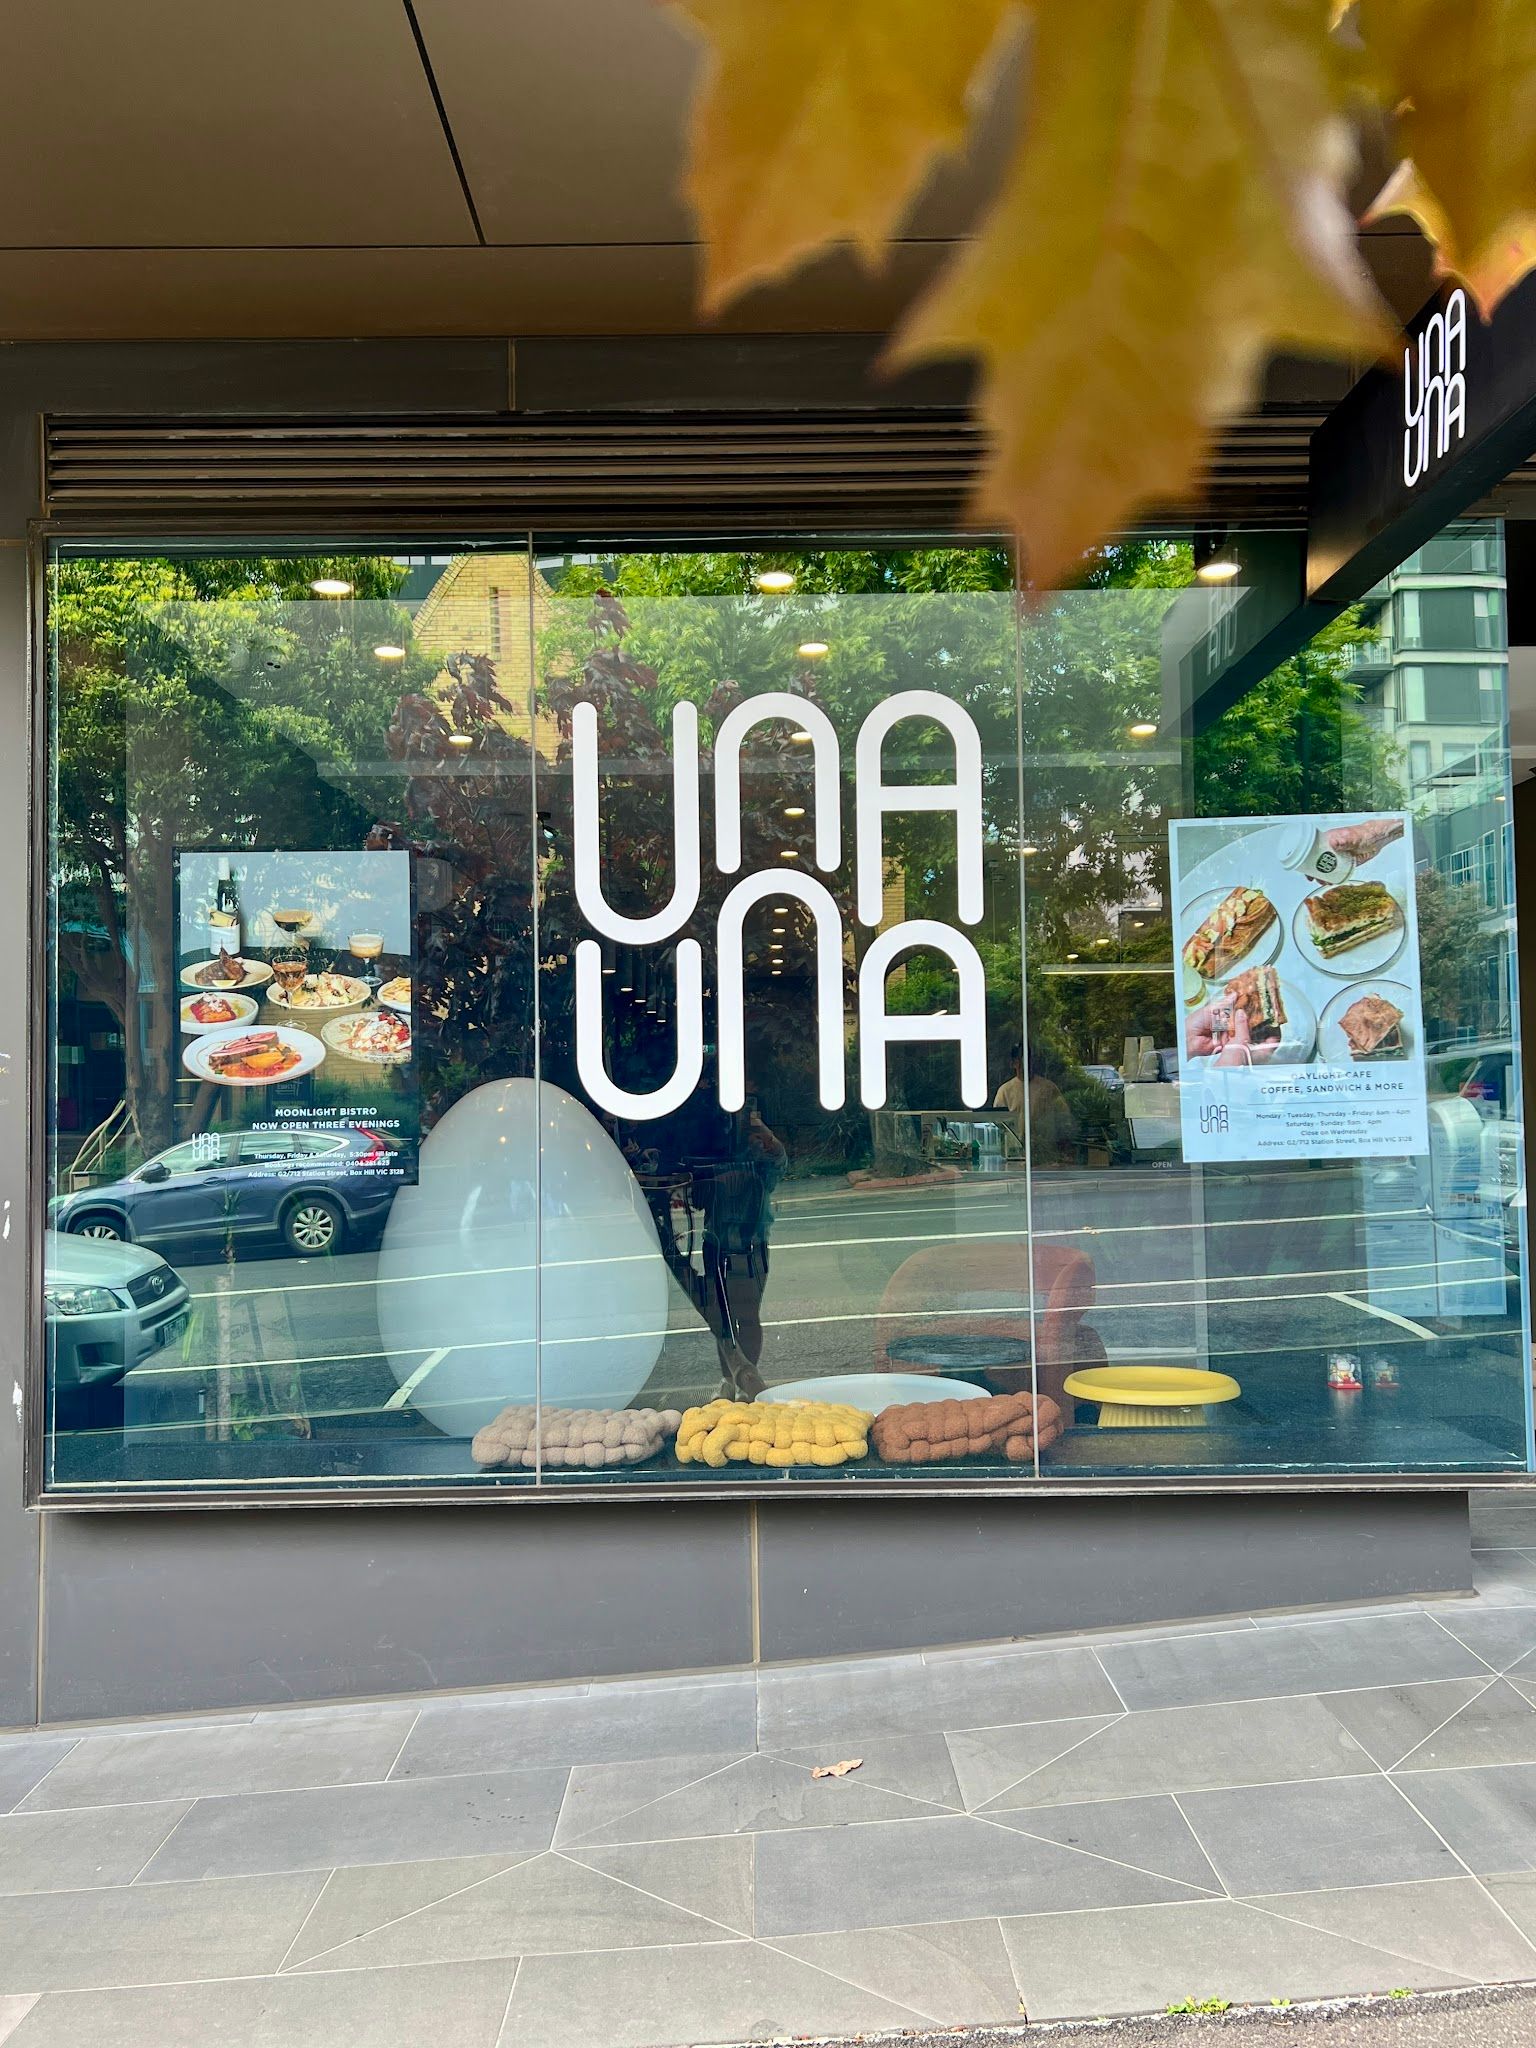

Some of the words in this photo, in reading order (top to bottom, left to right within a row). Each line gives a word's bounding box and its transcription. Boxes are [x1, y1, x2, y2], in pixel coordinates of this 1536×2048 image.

[1404, 288, 1466, 427] UNA
[1404, 373, 1466, 487] UNA
[573, 690, 985, 945] UNA
[575, 868, 989, 1121] UNA
[1291, 1072, 1342, 1080] DAYLIGHT
[1261, 1086, 1303, 1094] COFFEE,
[1306, 1084, 1362, 1093] SANDWICH
[275, 1107, 337, 1117] MOONLIGHT
[339, 1107, 378, 1116] BISTRO
[1199, 1104, 1229, 1122] UNA
[252, 1122, 278, 1130] NOW
[281, 1121, 310, 1130] OPEN
[312, 1120, 346, 1129] THREE
[348, 1119, 400, 1128] EVENINGS
[1200, 1116, 1229, 1134] UNA
[191, 1132, 220, 1150] UNA
[192, 1144, 220, 1161] UNA
[287, 1152, 309, 1160] Friday
[349, 1151, 375, 1159] 5:30pm
[1151, 1161, 1173, 1169] OPEN
[277, 1170, 300, 1178] G2/712
